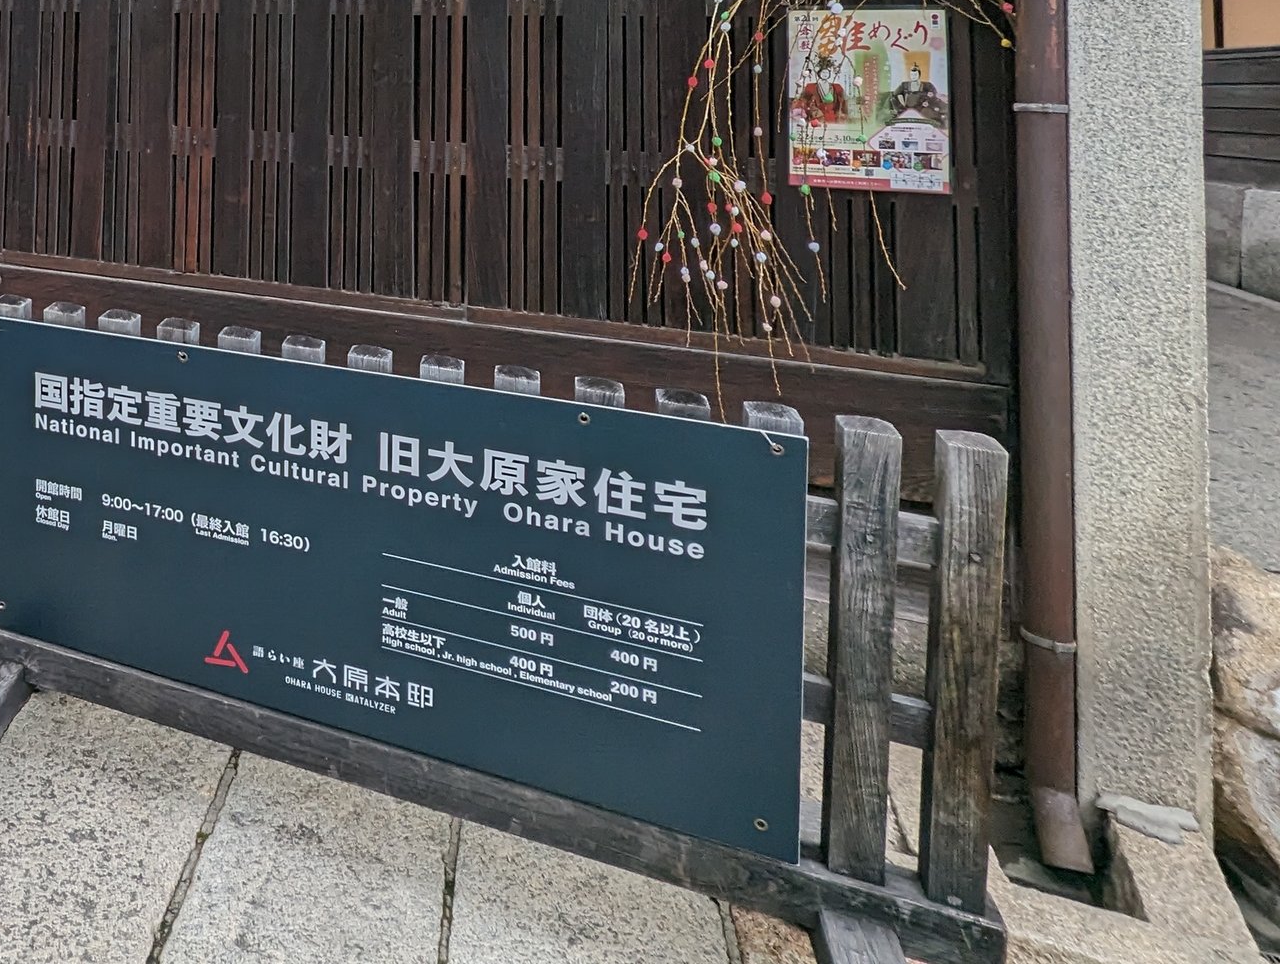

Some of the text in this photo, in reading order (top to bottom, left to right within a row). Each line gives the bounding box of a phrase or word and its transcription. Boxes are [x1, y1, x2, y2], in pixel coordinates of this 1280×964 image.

[34, 372, 707, 531] 国指定重要文化財 旧大原家住宅
[35, 413, 705, 559] National Important Cultural Property Ohara House
[35, 478, 82, 501] 開館時間
[35, 492, 52, 501] Open
[35, 505, 137, 540] 休館日 月曜日
[35, 516, 69, 531] Closed Day
[102, 531, 117, 542] Mon.
[195, 527, 249, 546] Last Admission
[493, 564, 575, 590] Admission Fees
[512, 554, 556, 577] 入館料
[382, 596, 408, 612] 一般
[517, 590, 545, 610] 個人
[382, 606, 407, 620] Adult
[507, 601, 555, 621] Individual
[588, 620, 622, 636] Group
[646, 634, 659, 643] or
[382, 622, 446, 649] 高校生以下
[252, 645, 434, 709] 語らい座 大原本邸
[382, 635, 403, 649] High
[442, 650, 454, 661] Jr.
[456, 654, 477, 668] high
[519, 670, 575, 693] Elementary
[578, 684, 612, 702] school
[285, 675, 396, 714] OHARA HOUSE KATALYZER
